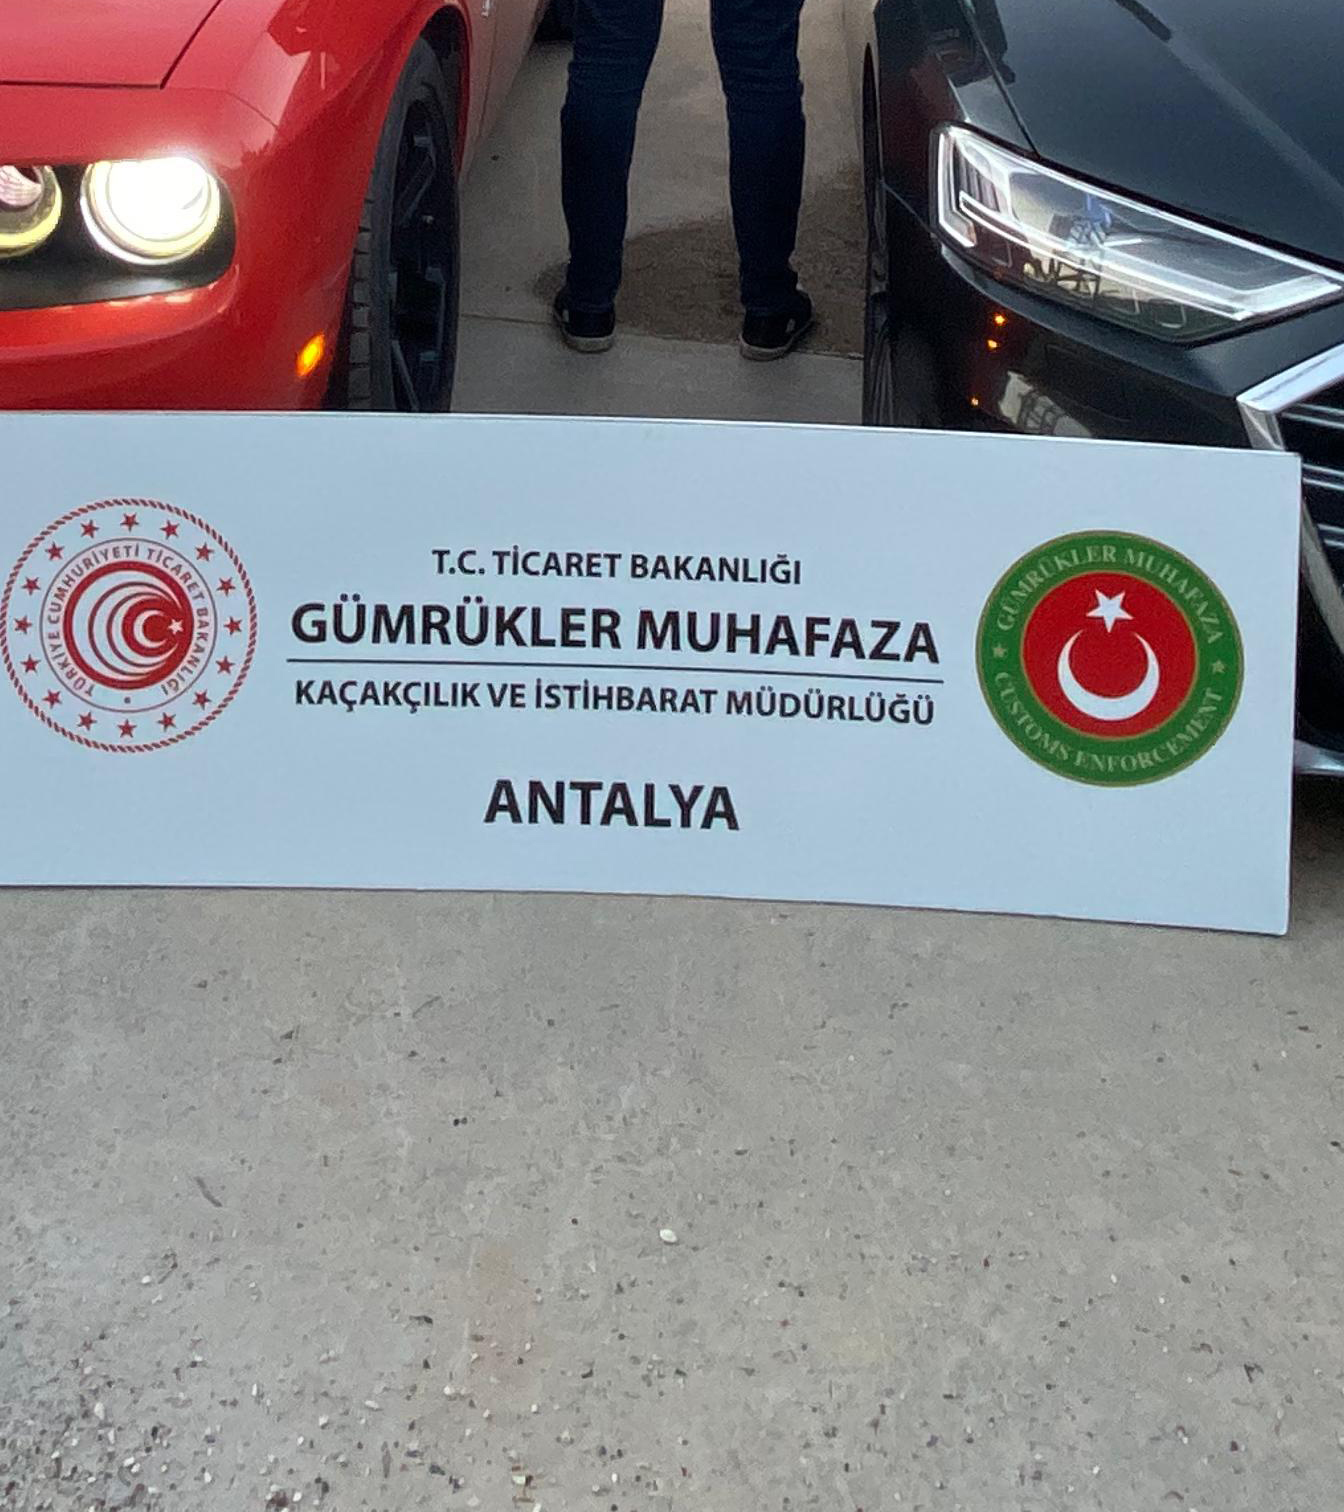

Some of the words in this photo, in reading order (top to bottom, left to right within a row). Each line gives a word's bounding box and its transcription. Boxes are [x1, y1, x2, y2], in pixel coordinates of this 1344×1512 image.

[47, 542, 140, 625] CUMHURİYETİ
[146, 546, 205, 600] TİCARET
[432, 549, 485, 575] T.C.
[492, 544, 623, 578] TİCARET
[630, 553, 802, 585] BAKANLIĞI
[1124, 547, 1224, 644] MUHAFAZA
[160, 607, 209, 696] BAKANLIĞI
[291, 593, 622, 649] GÜMRÜKLER
[636, 609, 941, 664] MUHAFAZA
[295, 679, 481, 714] KAÇAKÇILIK
[487, 683, 527, 709] VE
[535, 678, 718, 715] İSTİHBARAT
[725, 685, 935, 726] MÜDÜRLÜĞÜ
[994, 671, 1071, 762] CUSTOMS
[1073, 687, 1224, 773] ENFORCEMENT
[483, 778, 741, 831] ANTALYA
